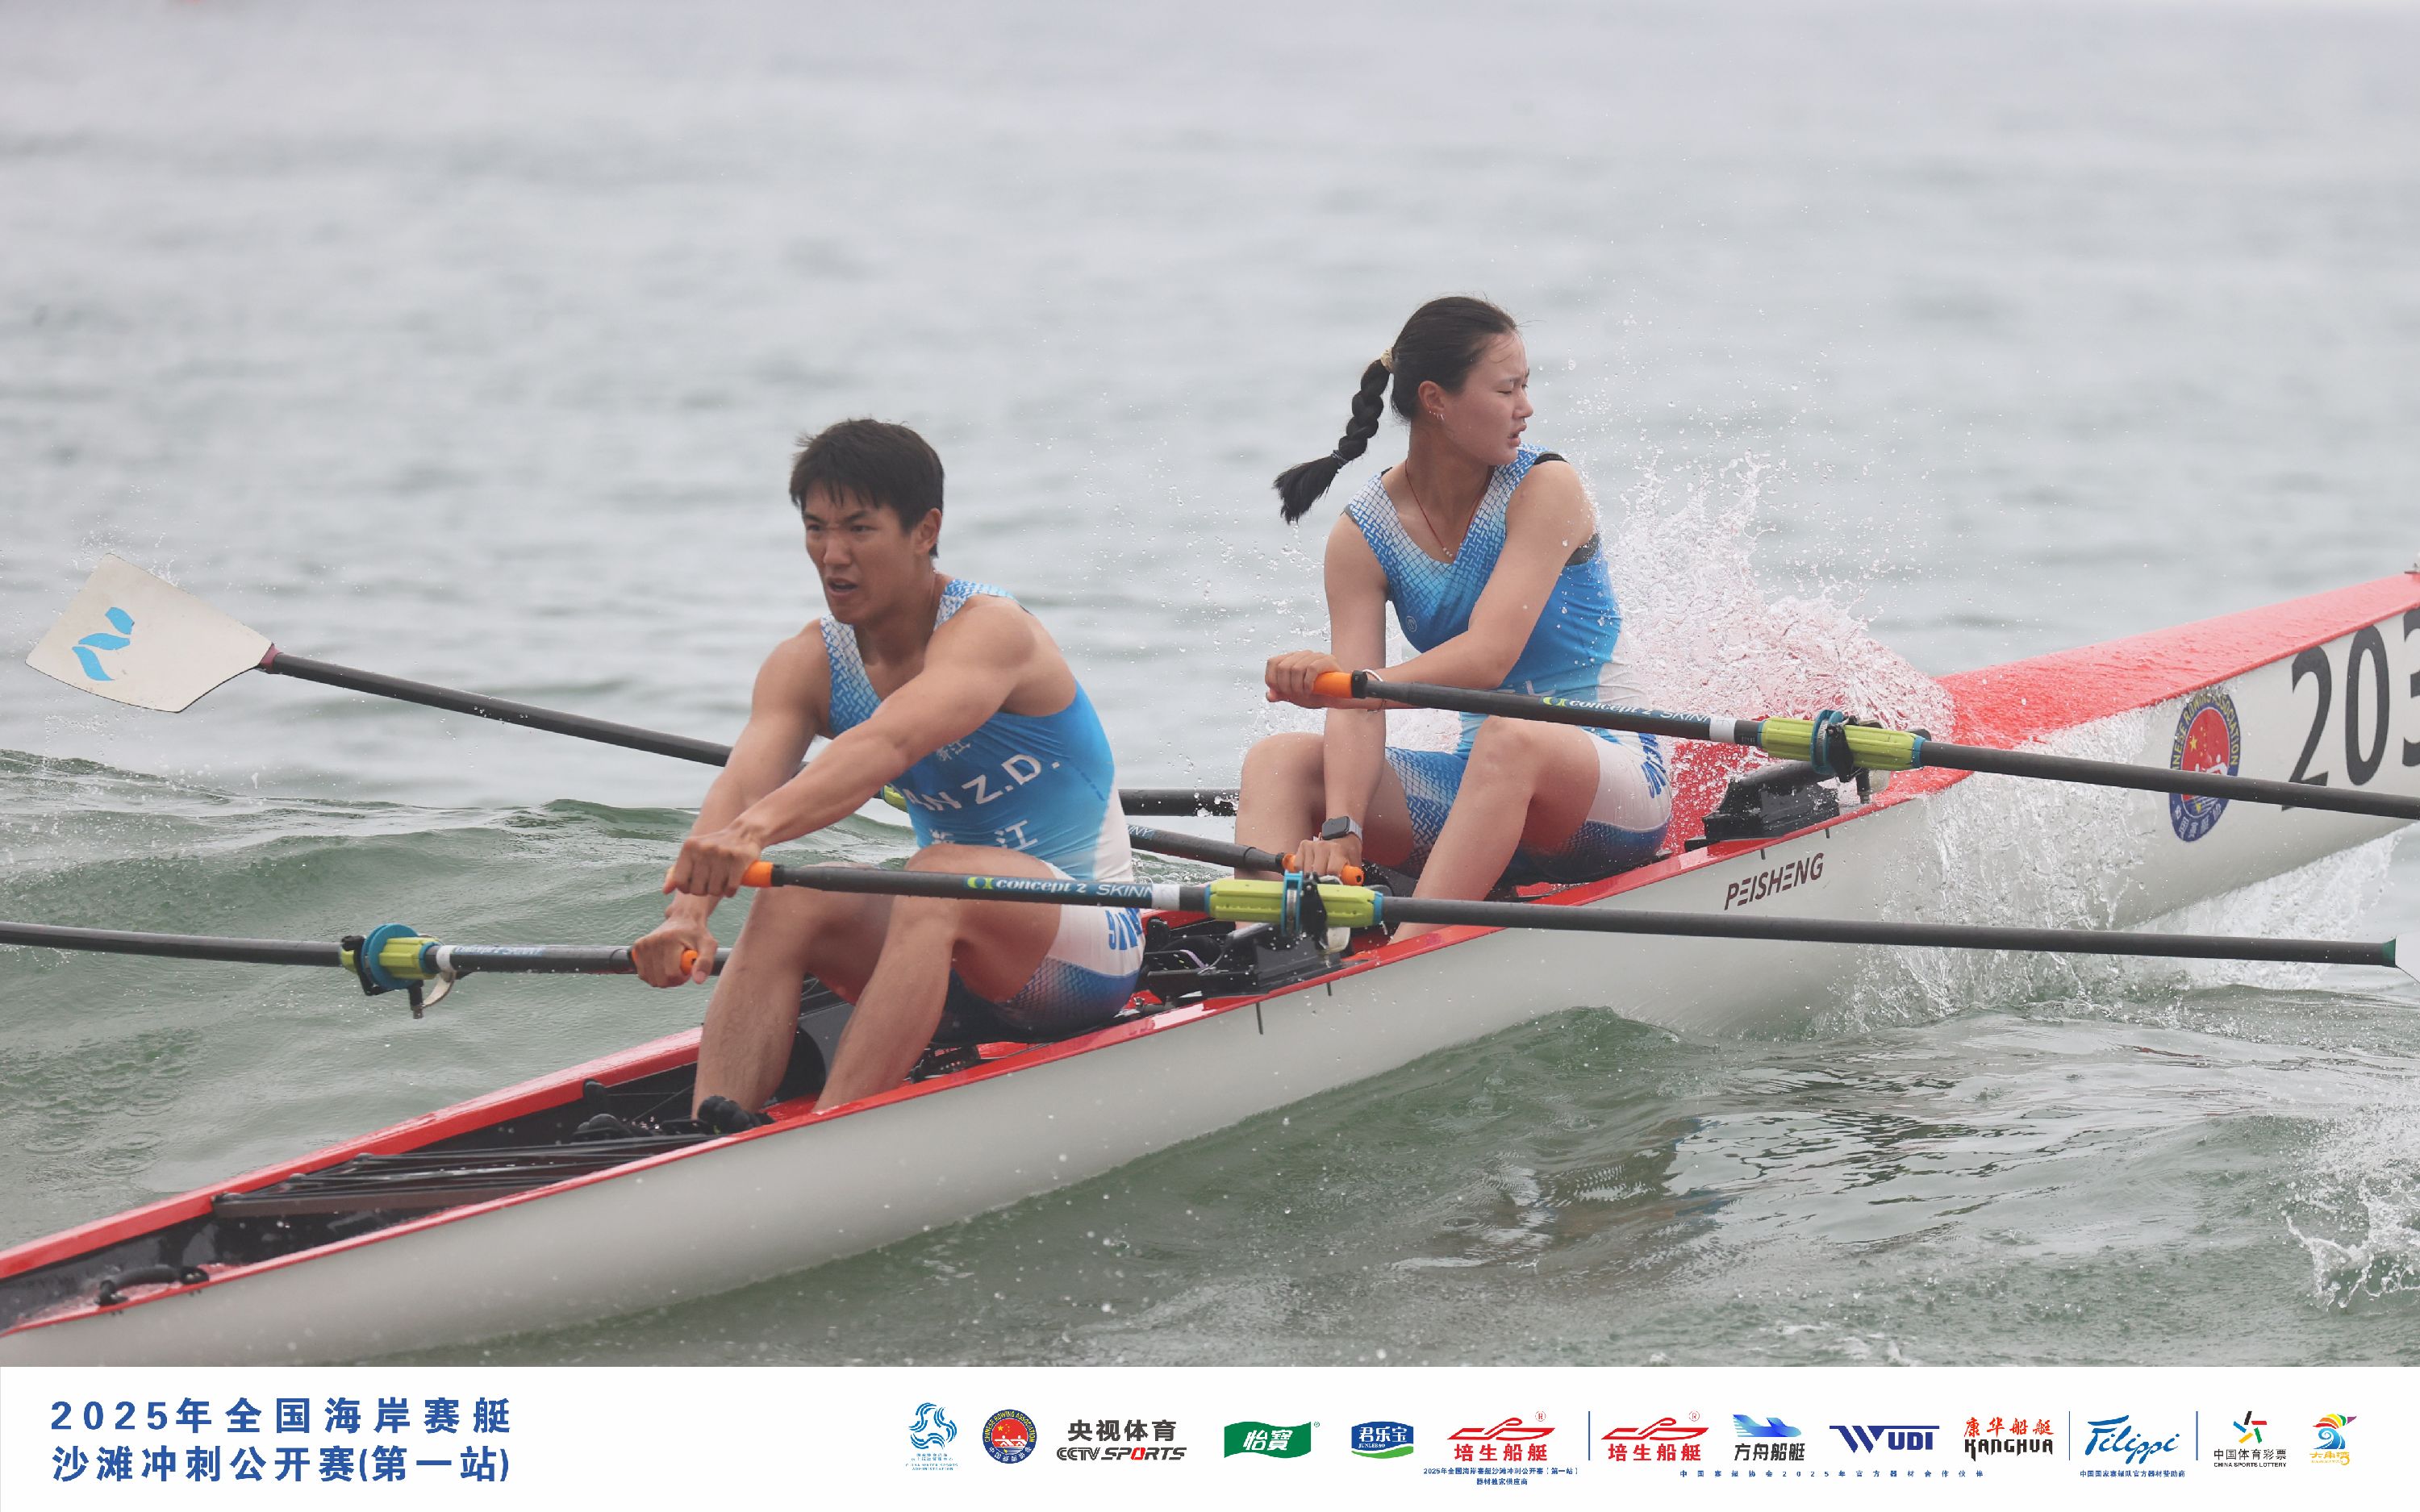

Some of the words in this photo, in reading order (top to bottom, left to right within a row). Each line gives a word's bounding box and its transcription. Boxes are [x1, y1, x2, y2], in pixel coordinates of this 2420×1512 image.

[961, 754, 1061, 806] Z.D.
[995, 878, 1070, 893] concept
[1075, 882, 1088, 894] 2
[1095, 883, 1152, 898] SKINN
[1724, 852, 1825, 911] PEISHENG
